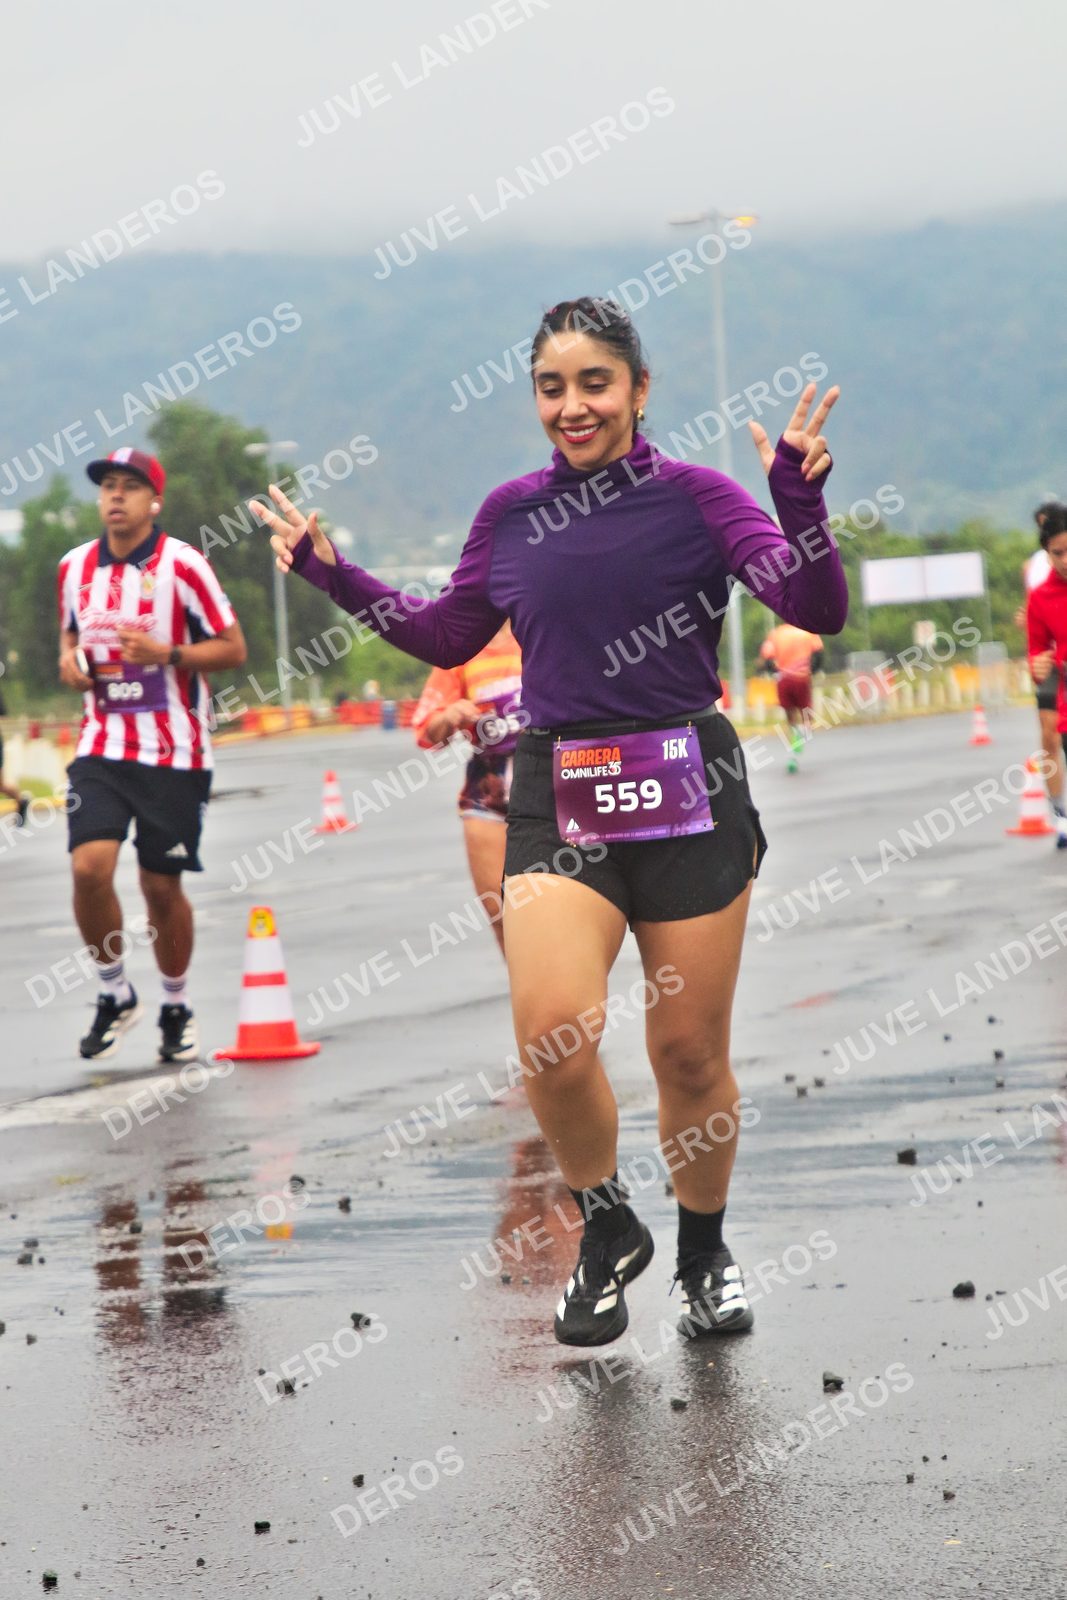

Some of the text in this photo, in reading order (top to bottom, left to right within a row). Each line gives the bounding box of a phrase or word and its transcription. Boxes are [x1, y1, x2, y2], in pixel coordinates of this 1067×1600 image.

[561, 746, 622, 767] CARRERA
[662, 737, 689, 760] 15K
[561, 767, 608, 780] OMNILIFE
[594, 778, 663, 814] 559
